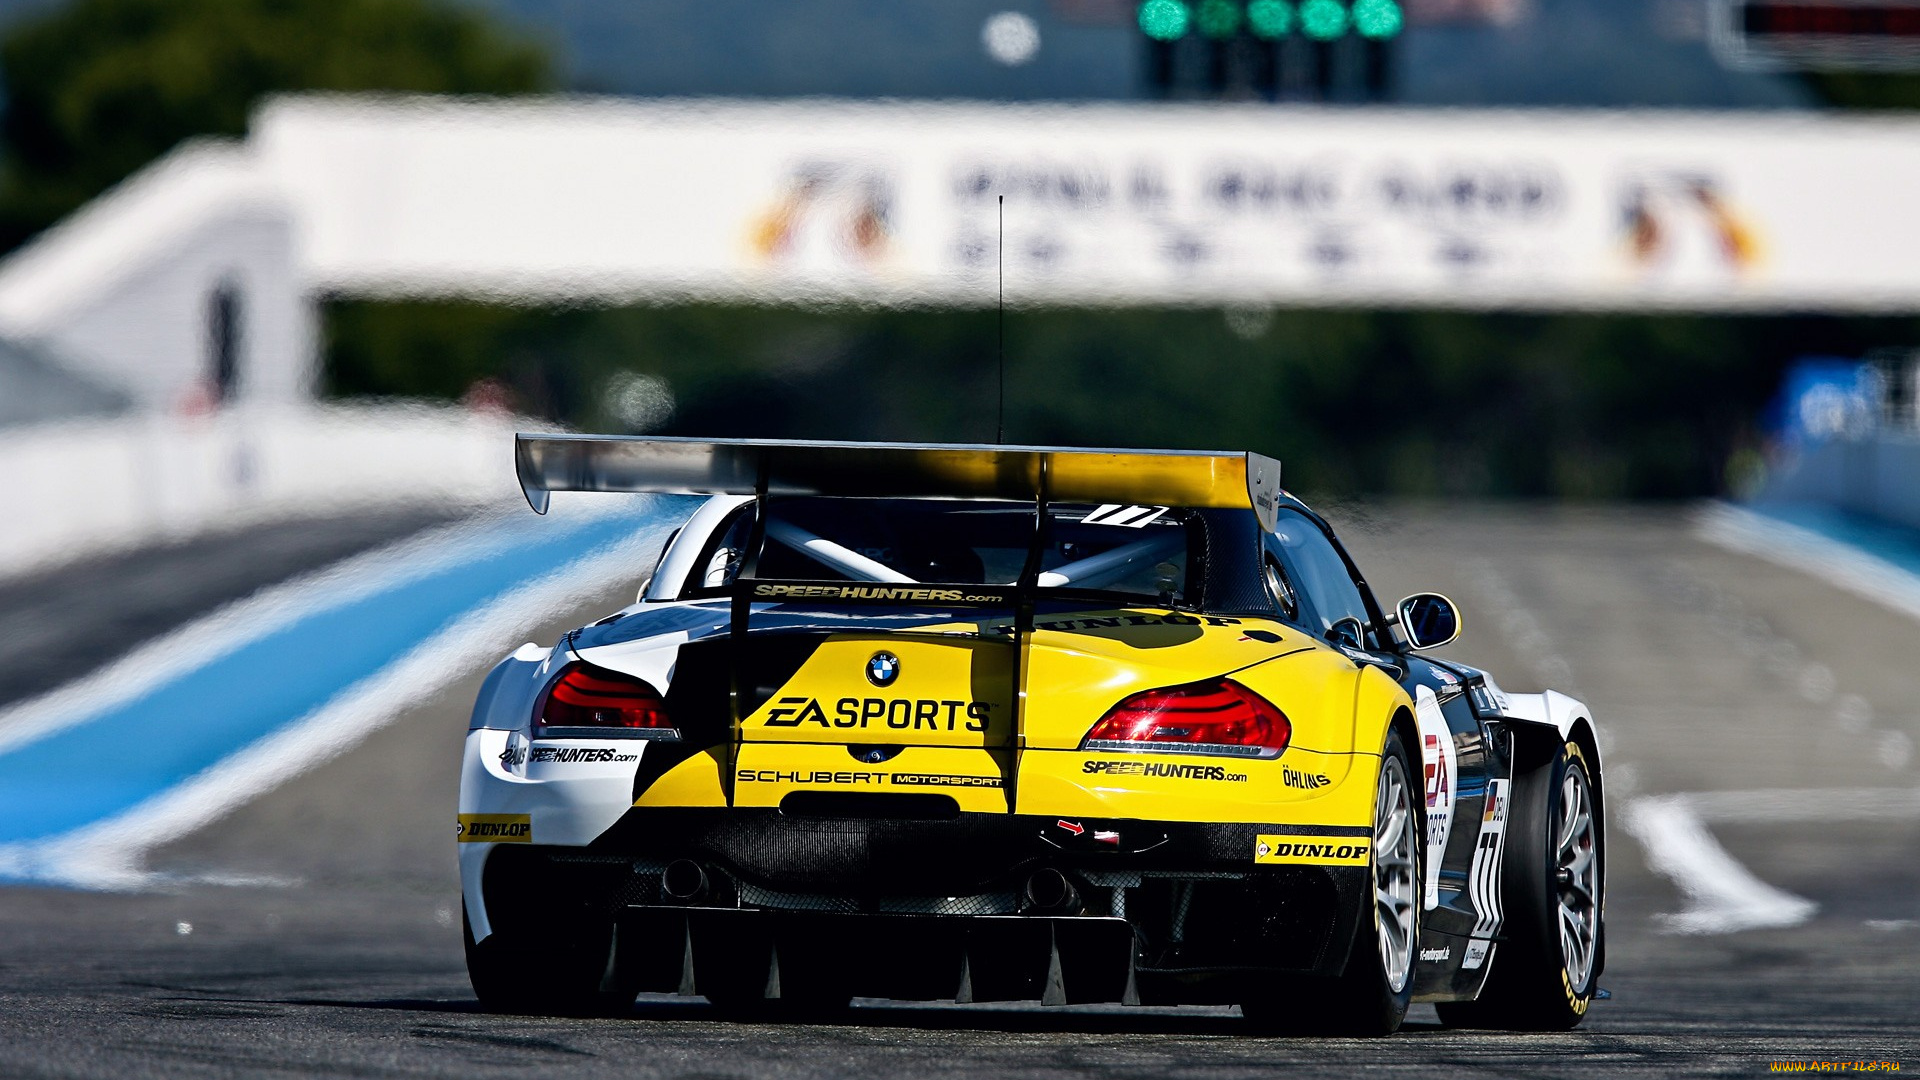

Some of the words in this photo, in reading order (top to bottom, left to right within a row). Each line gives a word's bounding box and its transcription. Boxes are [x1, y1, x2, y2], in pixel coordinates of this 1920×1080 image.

[754, 585, 1003, 602] SPEEDHUNTERS.com
[763, 697, 831, 728] EA
[834, 697, 991, 732] SPORTS
[737, 769, 889, 785] SCHUBERT
[896, 775, 1003, 787] MOTORSPORT
[1082, 761, 1248, 783] SPEEDHUNTERS.com
[1282, 764, 1331, 790] ÖHLINS
[468, 823, 531, 837] DUNLOP
[1426, 813, 1447, 846] ORTS
[1274, 843, 1369, 859] DUNLOP
